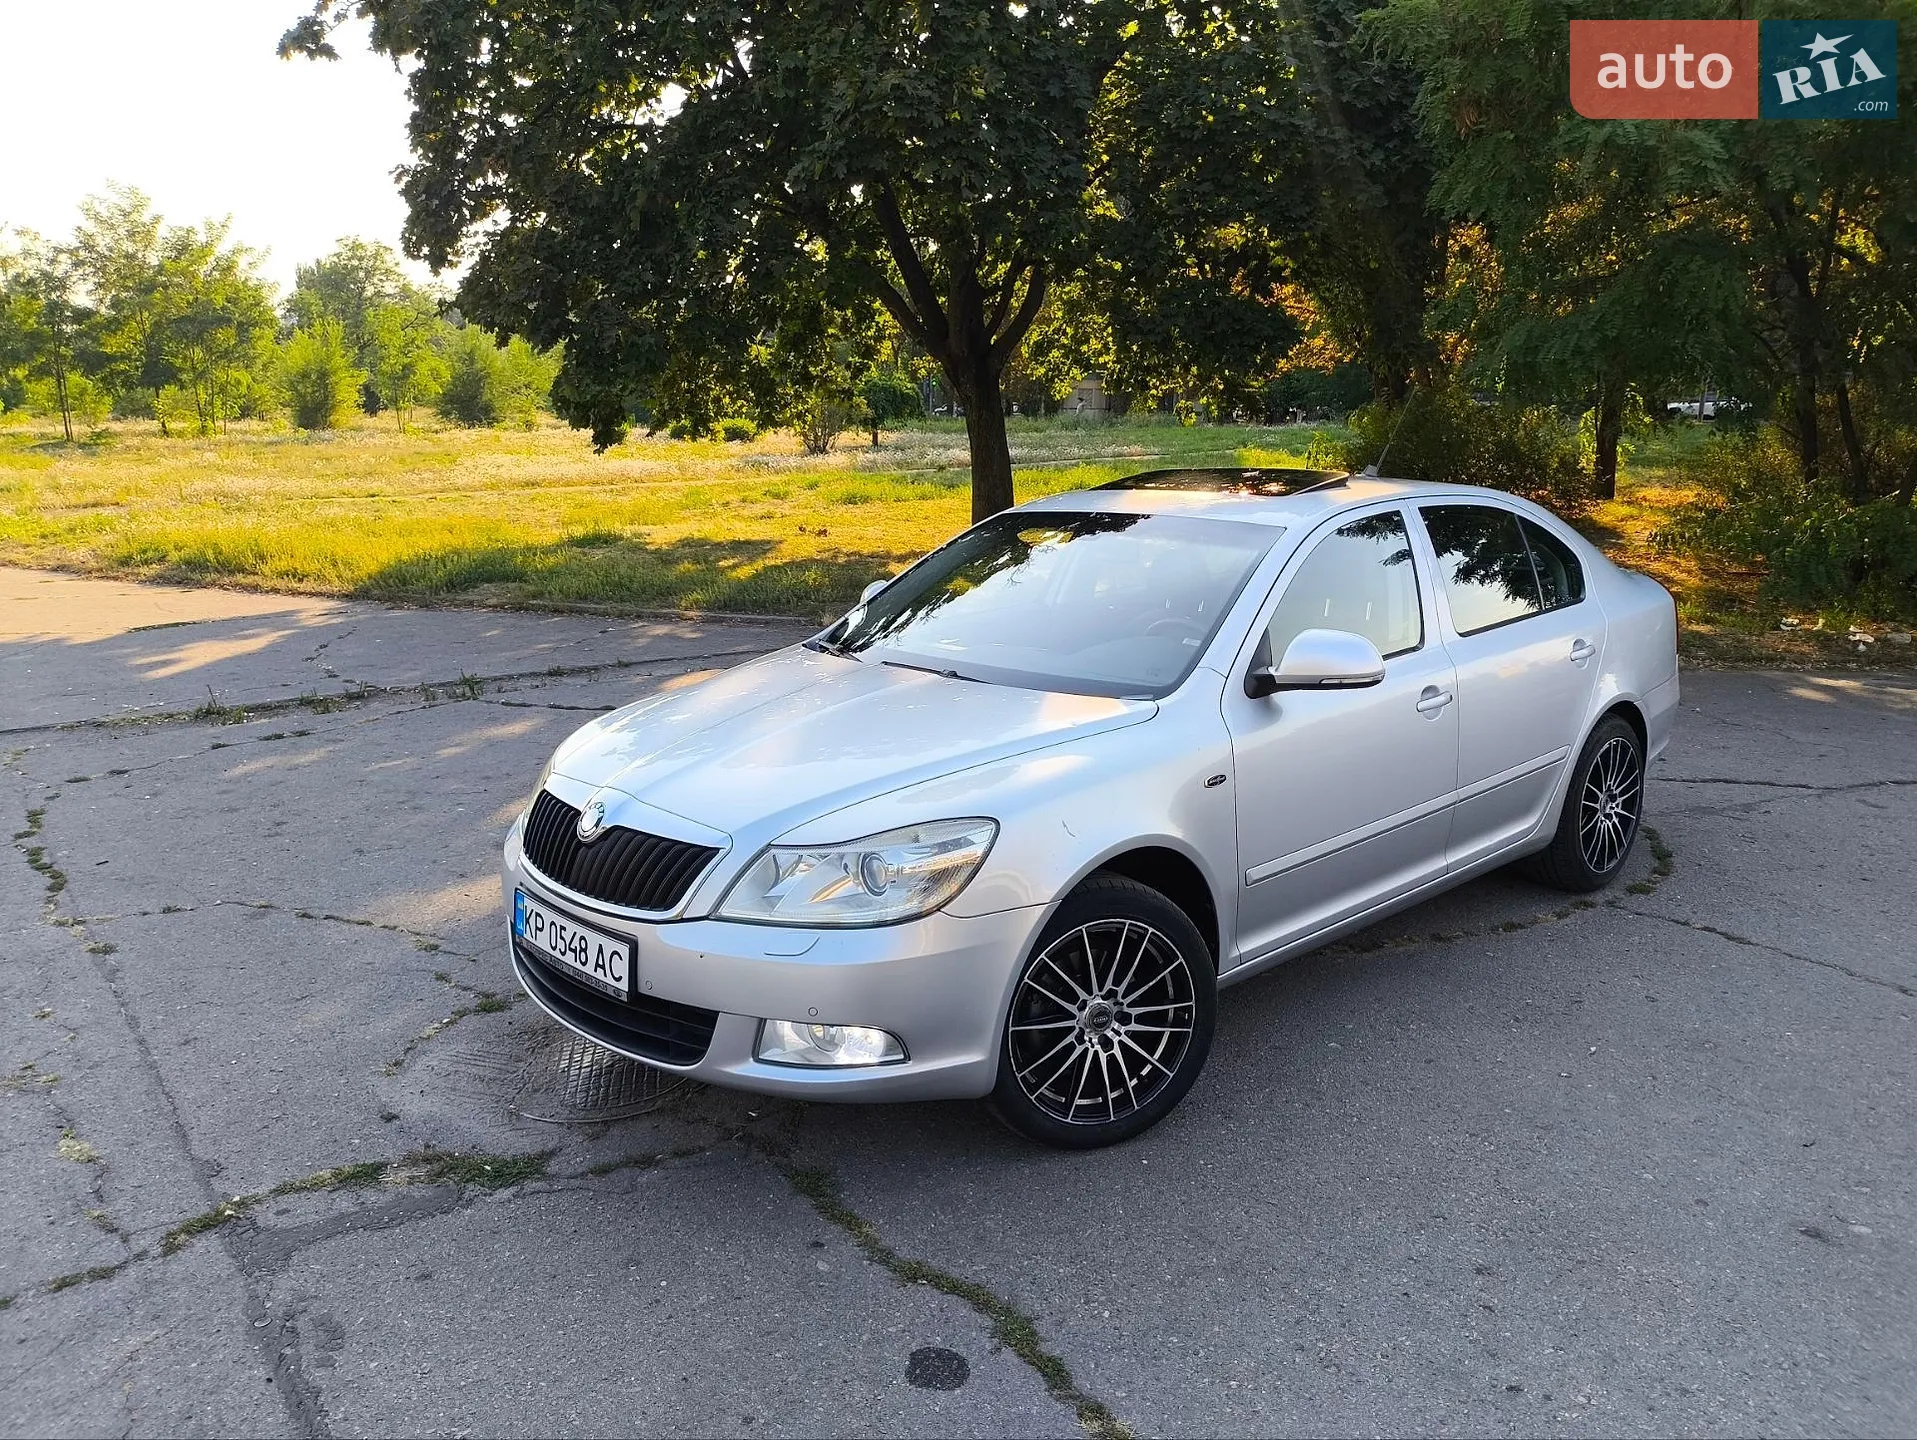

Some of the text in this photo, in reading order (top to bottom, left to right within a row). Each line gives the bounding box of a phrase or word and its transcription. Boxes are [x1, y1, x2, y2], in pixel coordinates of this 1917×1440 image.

[524, 905, 545, 941] KP
[549, 920, 589, 967] 0548
[593, 943, 624, 982] AC
